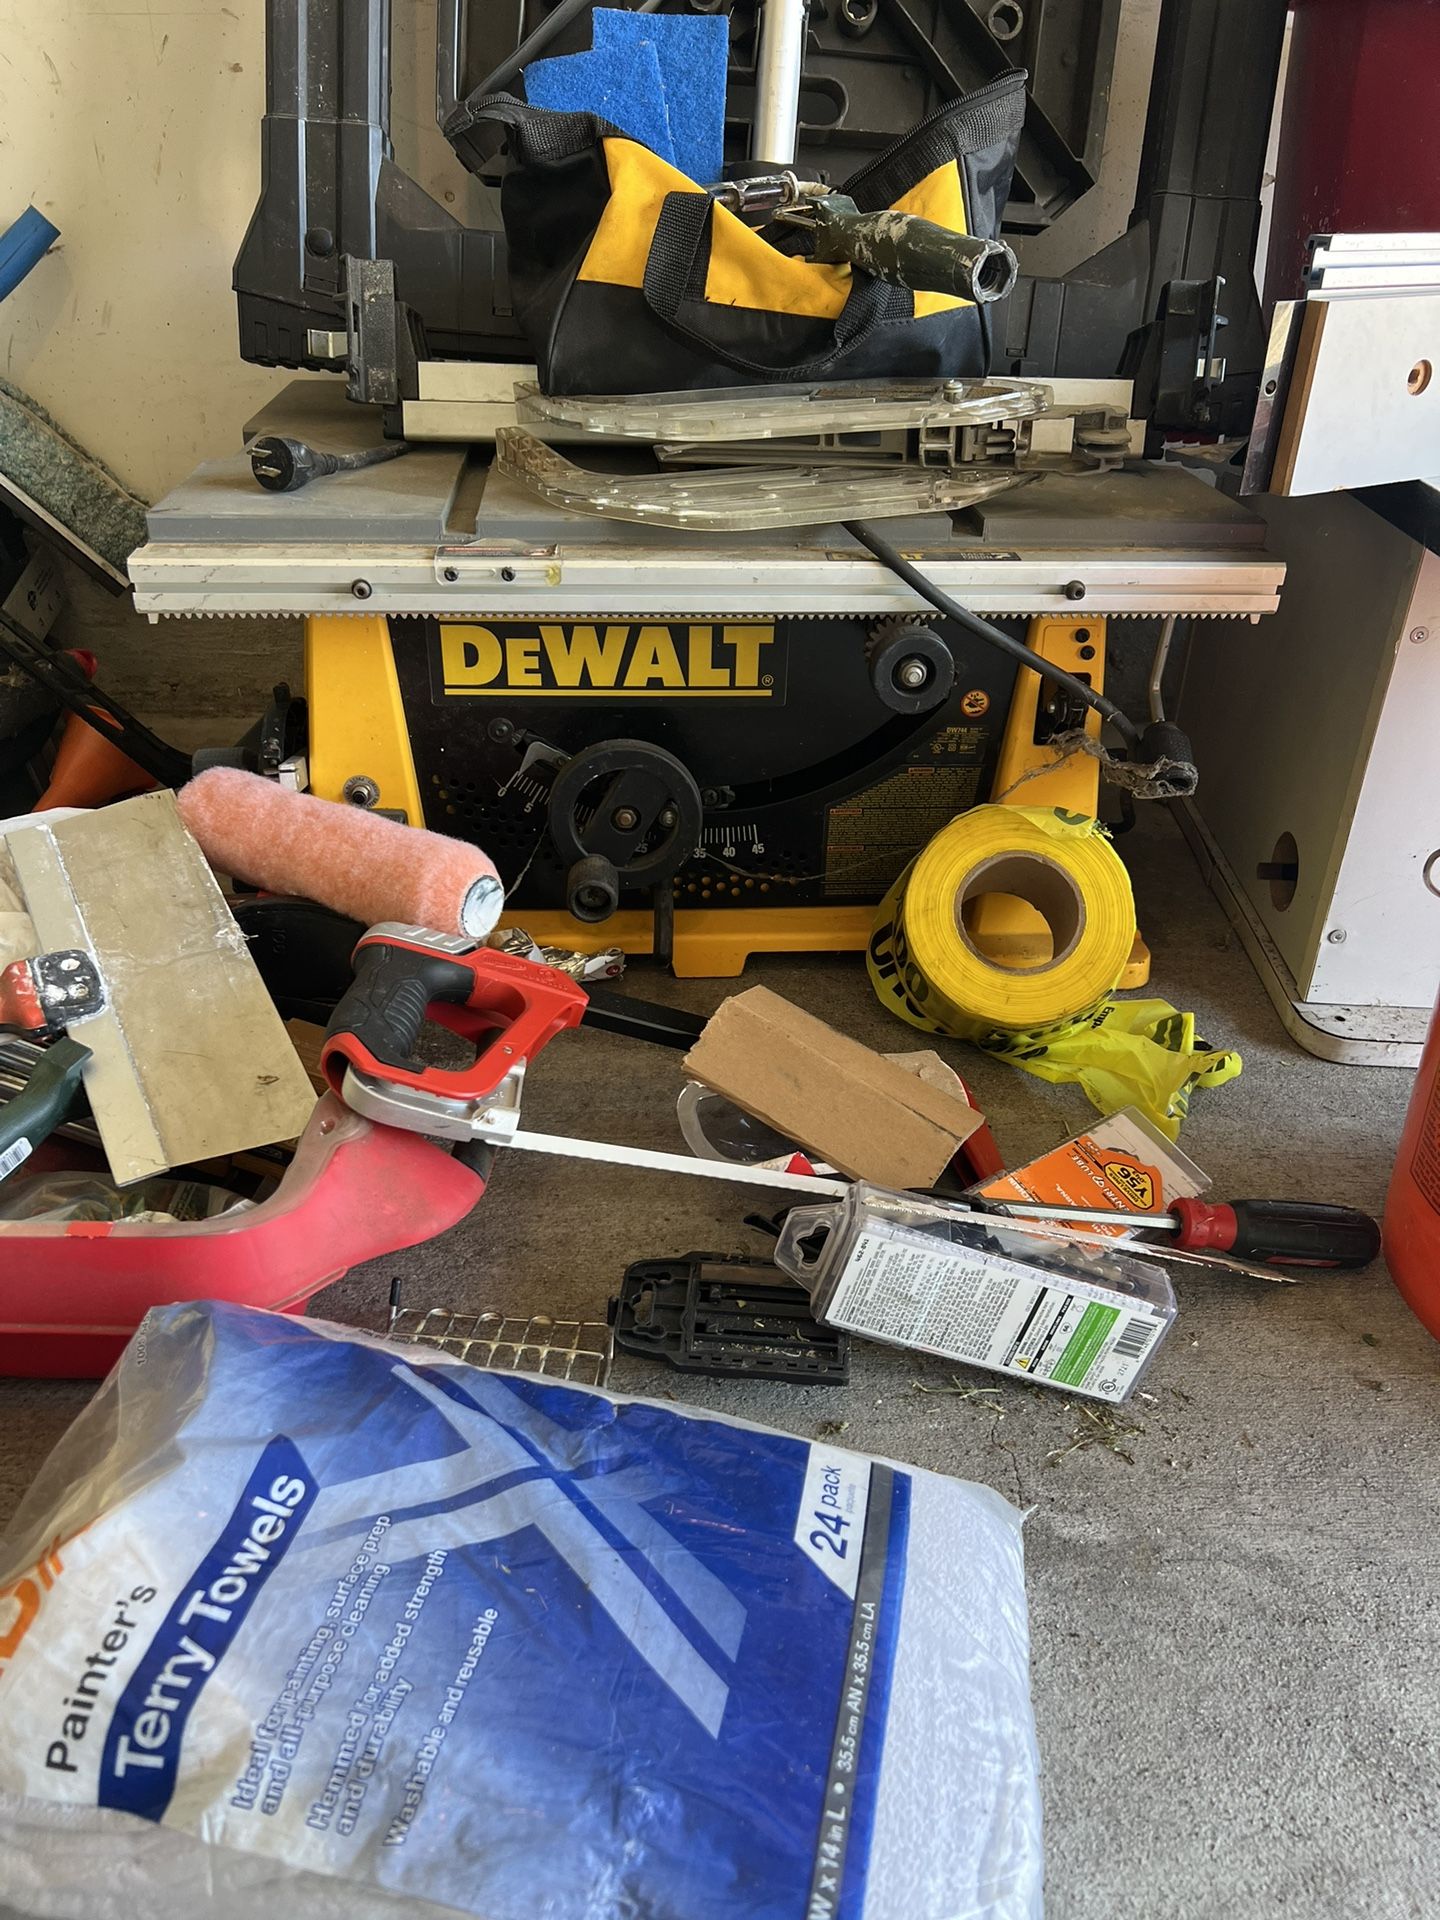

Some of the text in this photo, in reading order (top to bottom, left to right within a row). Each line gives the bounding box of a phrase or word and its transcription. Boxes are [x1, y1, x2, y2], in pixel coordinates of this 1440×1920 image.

[523, 802, 534, 813] 5
[692, 847, 707, 859] 35
[722, 846, 736, 858] 40
[751, 843, 765, 854] 45
[1119, 1166, 1148, 1199] Y56
[809, 1465, 851, 1560] 24 pack
[860, 1601, 876, 1622] LA
[114, 1474, 306, 1778] Terry Towels
[862, 1622, 873, 1641] cm
[231, 1514, 392, 1810] Ideal for painting, surface prep
[853, 1639, 870, 1673] 35.5
[45, 1584, 157, 1773] Painter's
[261, 1562, 392, 1816] and all-purpose cleaning
[306, 1548, 448, 1831] Hemmed for added strength
[853, 1674, 865, 1687] x
[847, 1687, 863, 1713] AN
[382, 1606, 499, 1846] Washable and reusable
[848, 1715, 859, 1736] cm
[336, 1675, 415, 1836] and durability
[836, 1735, 855, 1773] 35.5
[826, 1806, 846, 1822] L
[827, 1824, 845, 1842] in
[818, 1842, 841, 1869] 14
[808, 1893, 833, 1920] W
